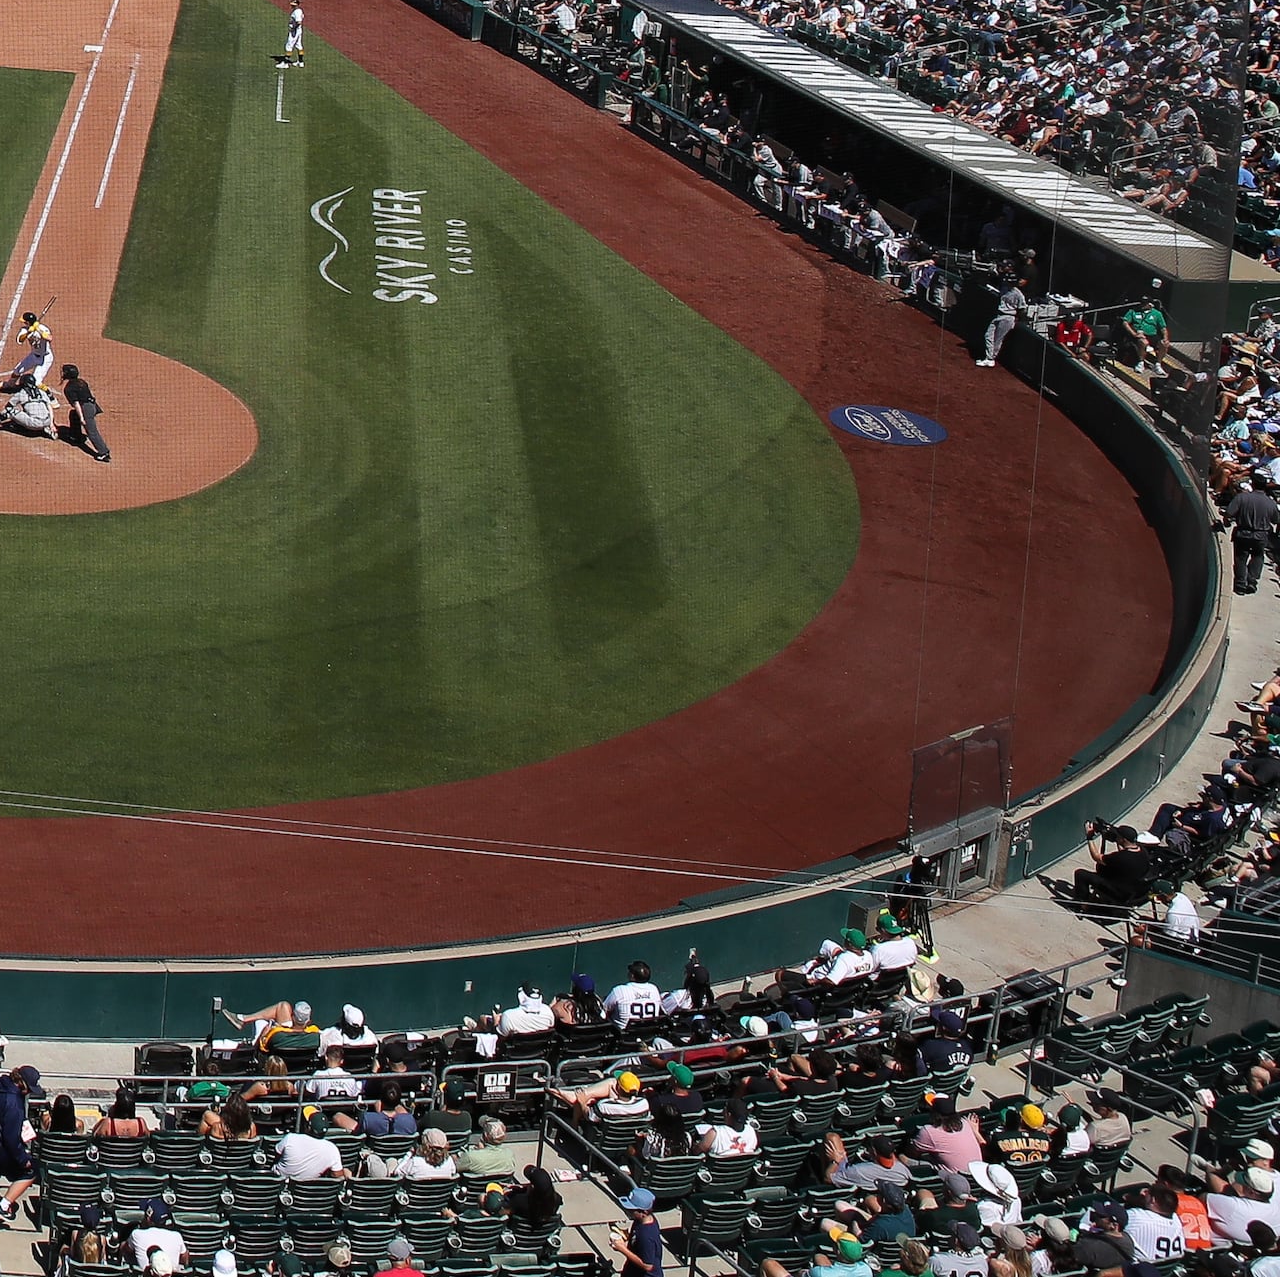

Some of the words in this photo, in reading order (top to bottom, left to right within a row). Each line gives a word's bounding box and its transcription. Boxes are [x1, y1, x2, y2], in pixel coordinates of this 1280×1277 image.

[371, 188, 428, 250] RIVER
[445, 219, 474, 274] CASINO
[372, 254, 439, 304] SKY
[630, 1003, 656, 1019] 99
[948, 1052, 970, 1066] JETER
